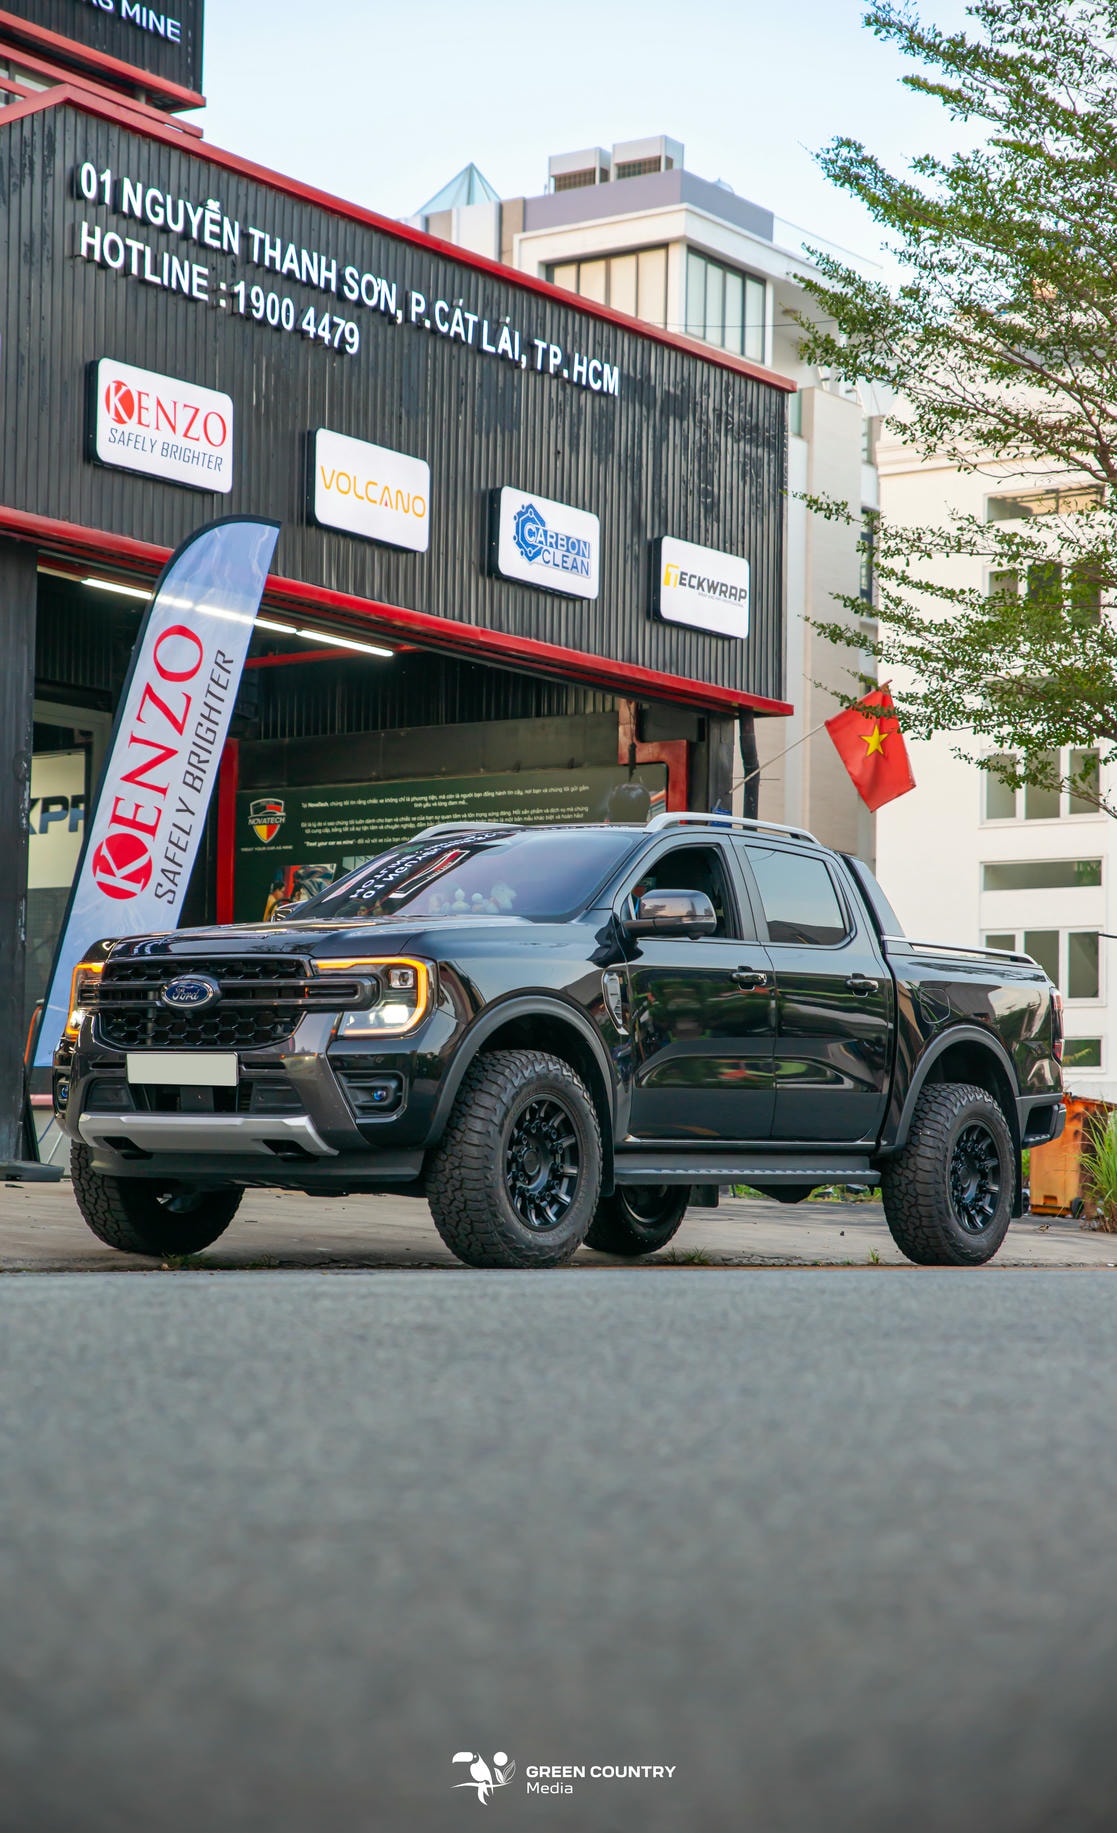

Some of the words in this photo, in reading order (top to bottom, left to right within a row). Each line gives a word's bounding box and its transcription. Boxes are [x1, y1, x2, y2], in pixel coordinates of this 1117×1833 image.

[121, 0, 181, 43] MINE
[80, 162, 112, 205] 01
[122, 177, 240, 256] NGUYỄN
[249, 226, 337, 293] THANH
[343, 265, 403, 325] SƠN,
[80, 221, 209, 302] HOTLINE
[301, 306, 360, 355] 4479
[105, 380, 227, 448] KENZO
[108, 428, 158, 454] SAFELY
[160, 442, 223, 472] BRIGHTER
[320, 465, 426, 518] VOLCANO
[523, 524, 591, 559] CARBON
[541, 549, 590, 577] CLEAN
[92, 624, 203, 900] KENZO
[154, 796, 197, 904] SAFELY
[182, 649, 235, 794] BRIGHTER
[248, 816, 286, 825] NOVATECH
[171, 984, 200, 1001] Ford
